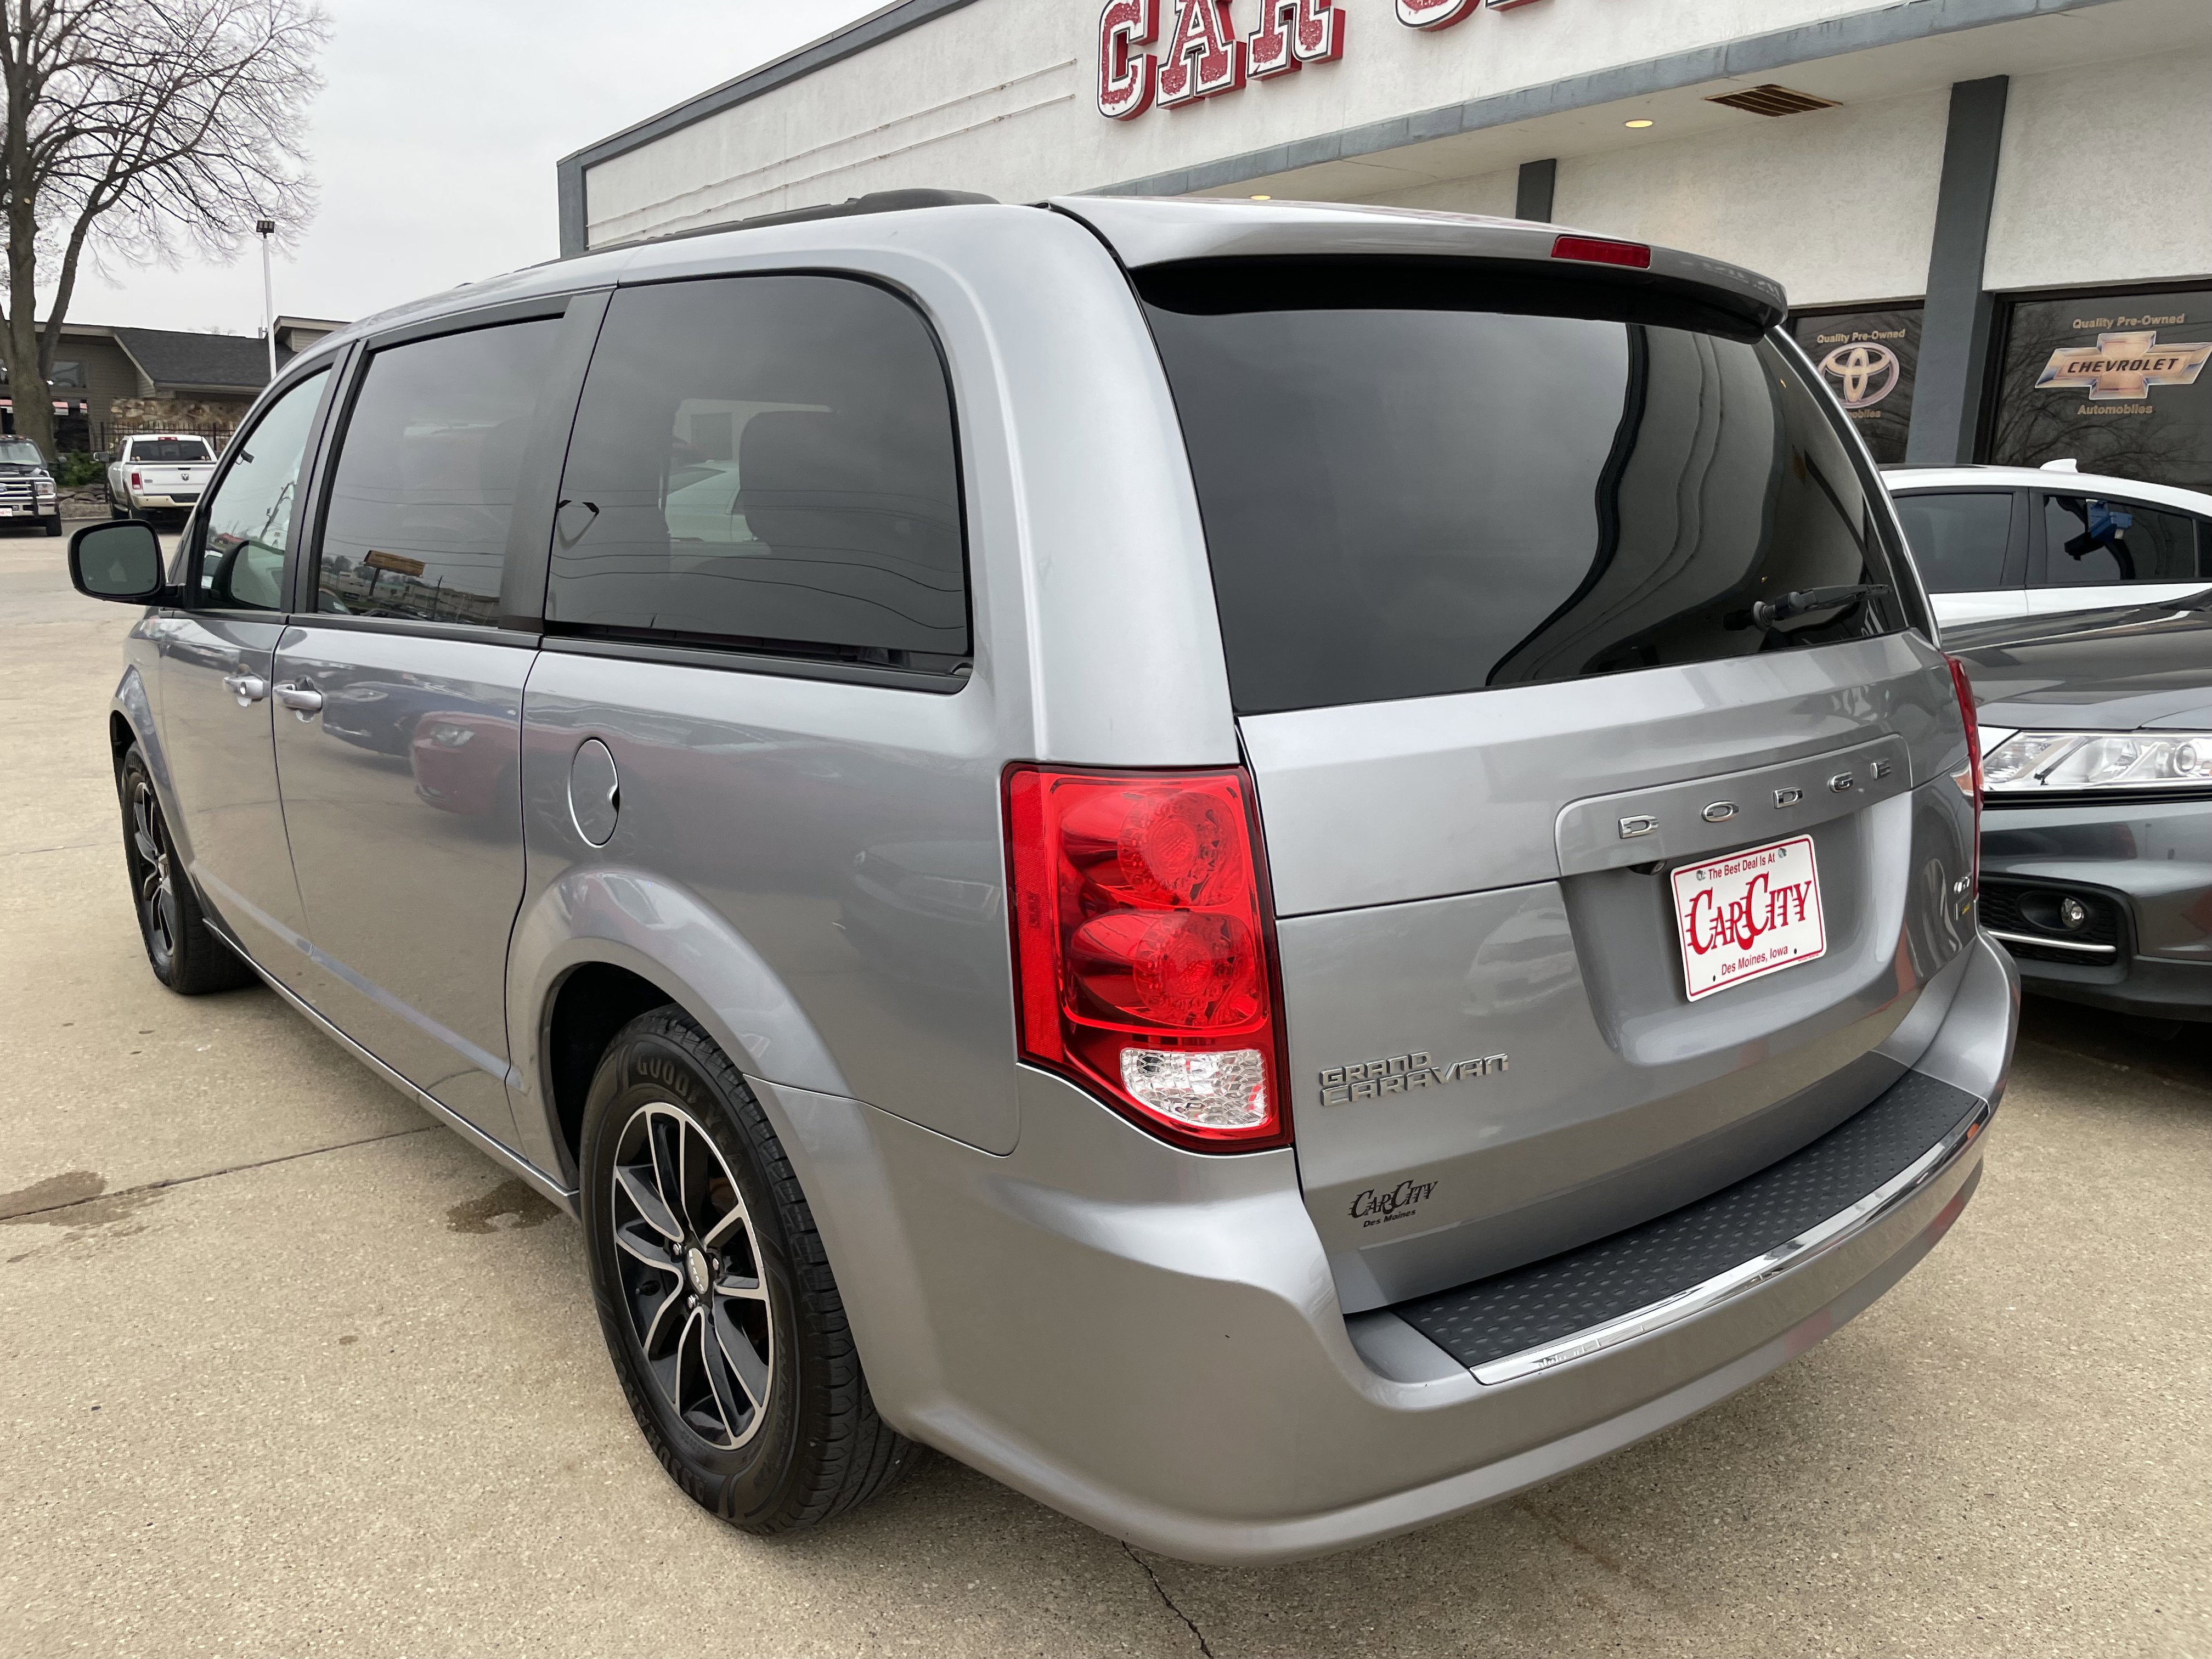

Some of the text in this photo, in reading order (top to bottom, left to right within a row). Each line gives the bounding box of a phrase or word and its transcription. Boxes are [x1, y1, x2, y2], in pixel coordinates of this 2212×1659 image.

[2073, 313, 2185, 329] Quality Pre-Owned
[1817, 329, 1906, 344] Quality Pre-Owned
[2067, 358, 2179, 373] CHEVROLET
[2078, 404, 2153, 415] Automobiles
[1618, 757, 1892, 839] DODGE
[1708, 853, 1775, 880] The Best Deal Is At
[1722, 962, 1736, 975] Des
[1738, 953, 1768, 969] Moines,
[1770, 945, 1788, 959] Iowa
[1319, 1051, 1431, 1086] GRAND
[1320, 1052, 1509, 1107] CARAVAN
[1363, 1209, 1417, 1227] Des Moines
